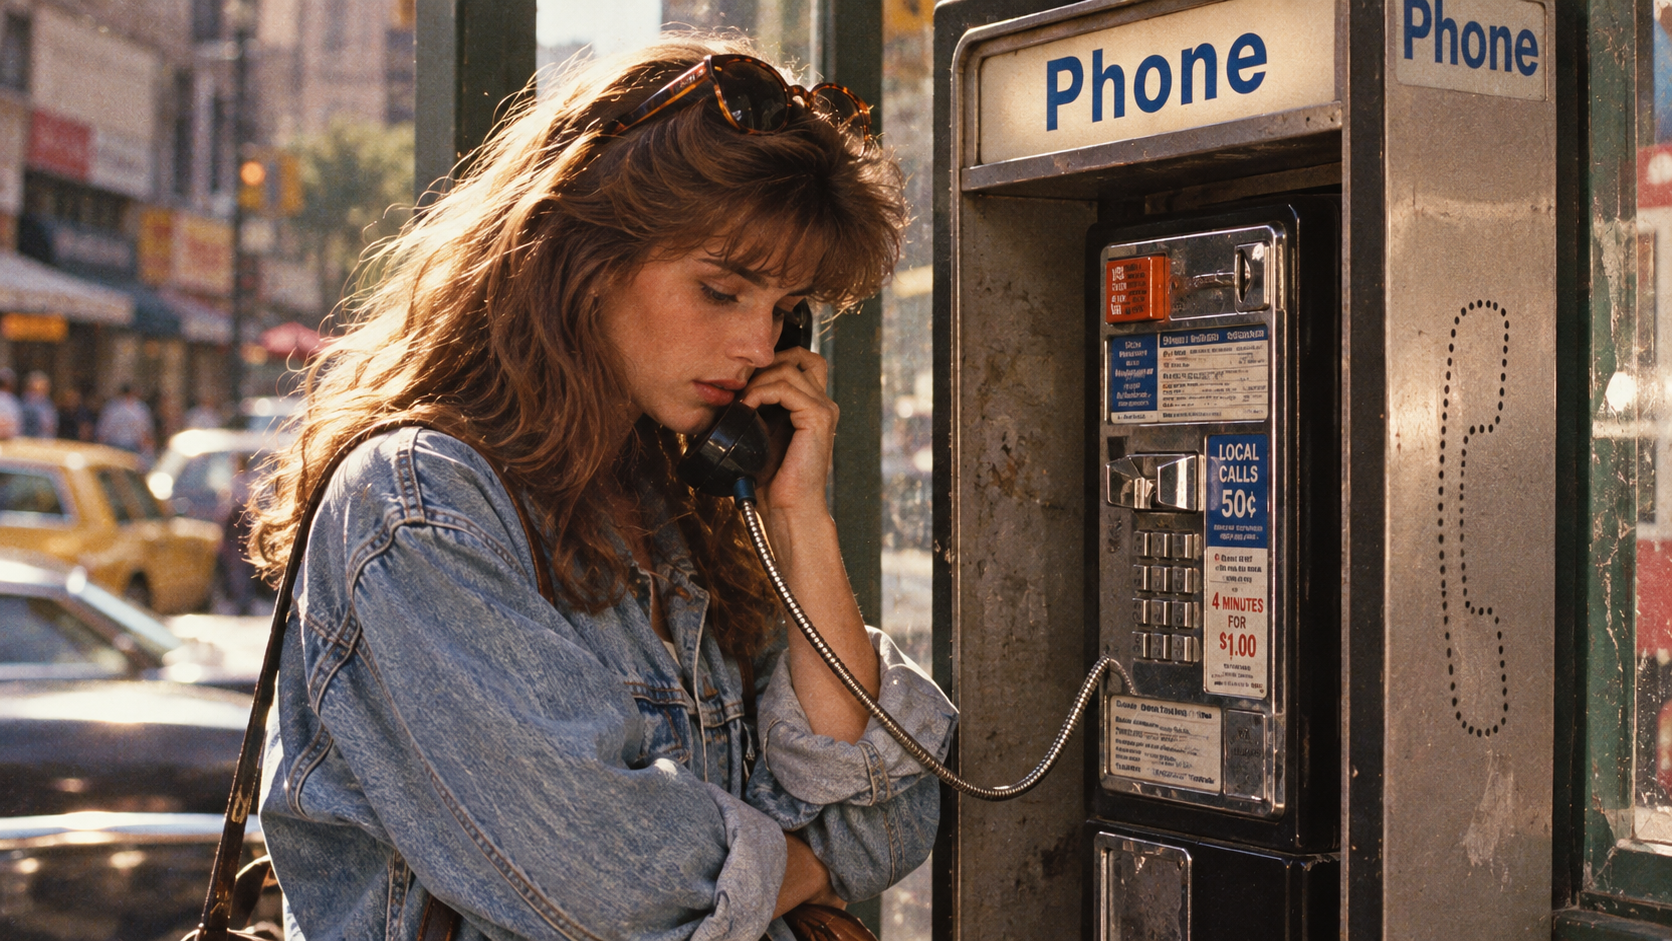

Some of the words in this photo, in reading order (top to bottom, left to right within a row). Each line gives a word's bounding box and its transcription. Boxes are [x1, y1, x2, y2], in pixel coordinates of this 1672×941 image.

[1404, 0, 1538, 76] Phone
[1046, 33, 1267, 131] Phone
[1219, 443, 1260, 462] LOCAL
[1219, 465, 1259, 483] CALLS
[1221, 489, 1257, 519] 50¢
[1212, 591, 1220, 610] 4
[1222, 596, 1264, 613] MINUTES
[1228, 614, 1247, 629] FOR
[1219, 631, 1257, 658] $1.00
